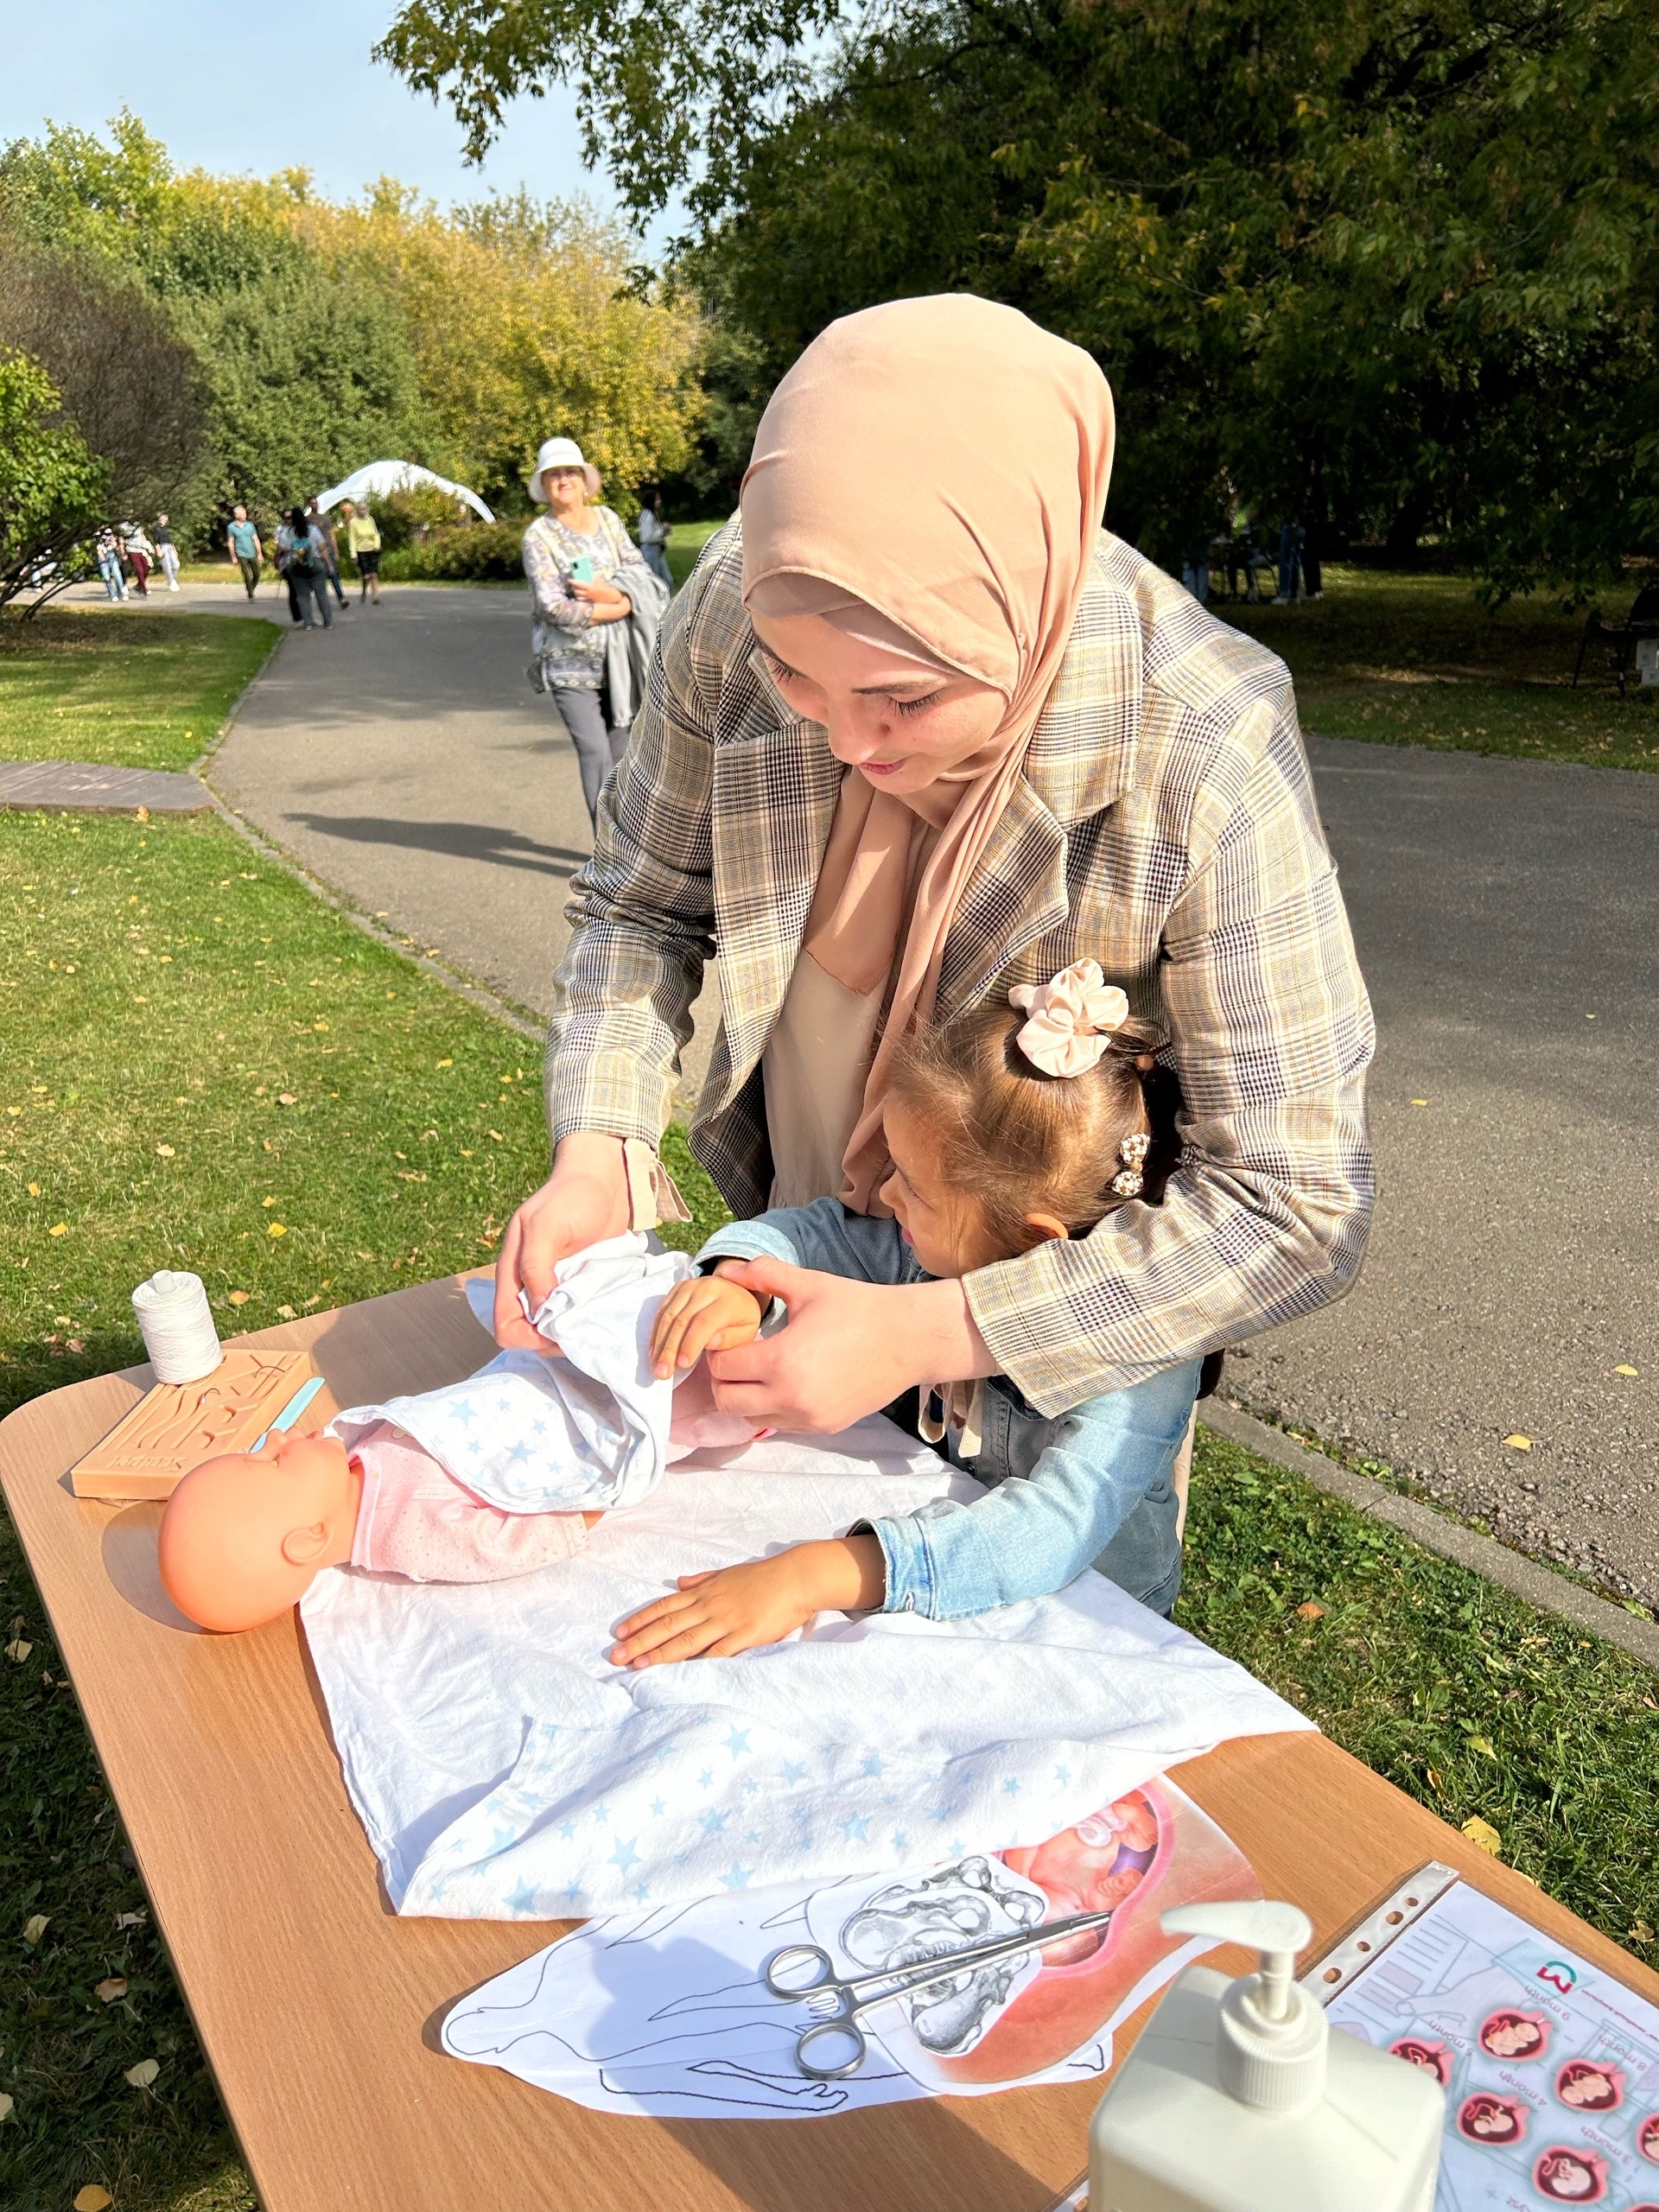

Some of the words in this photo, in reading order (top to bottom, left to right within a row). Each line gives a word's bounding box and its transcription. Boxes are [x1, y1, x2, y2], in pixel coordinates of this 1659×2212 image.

[1524, 1986, 1561, 2012] month
[1561, 2012, 1573, 2021] 9
[1428, 2020, 1465, 2049] month
[1465, 2047, 1475, 2057] 5
[1598, 2035, 1637, 2064] month
[1637, 2062, 1647, 2070] 8
[1499, 2070, 1538, 2100] month
[1580, 2126, 1623, 2157] month
[1621, 2155, 1632, 2164] 3
